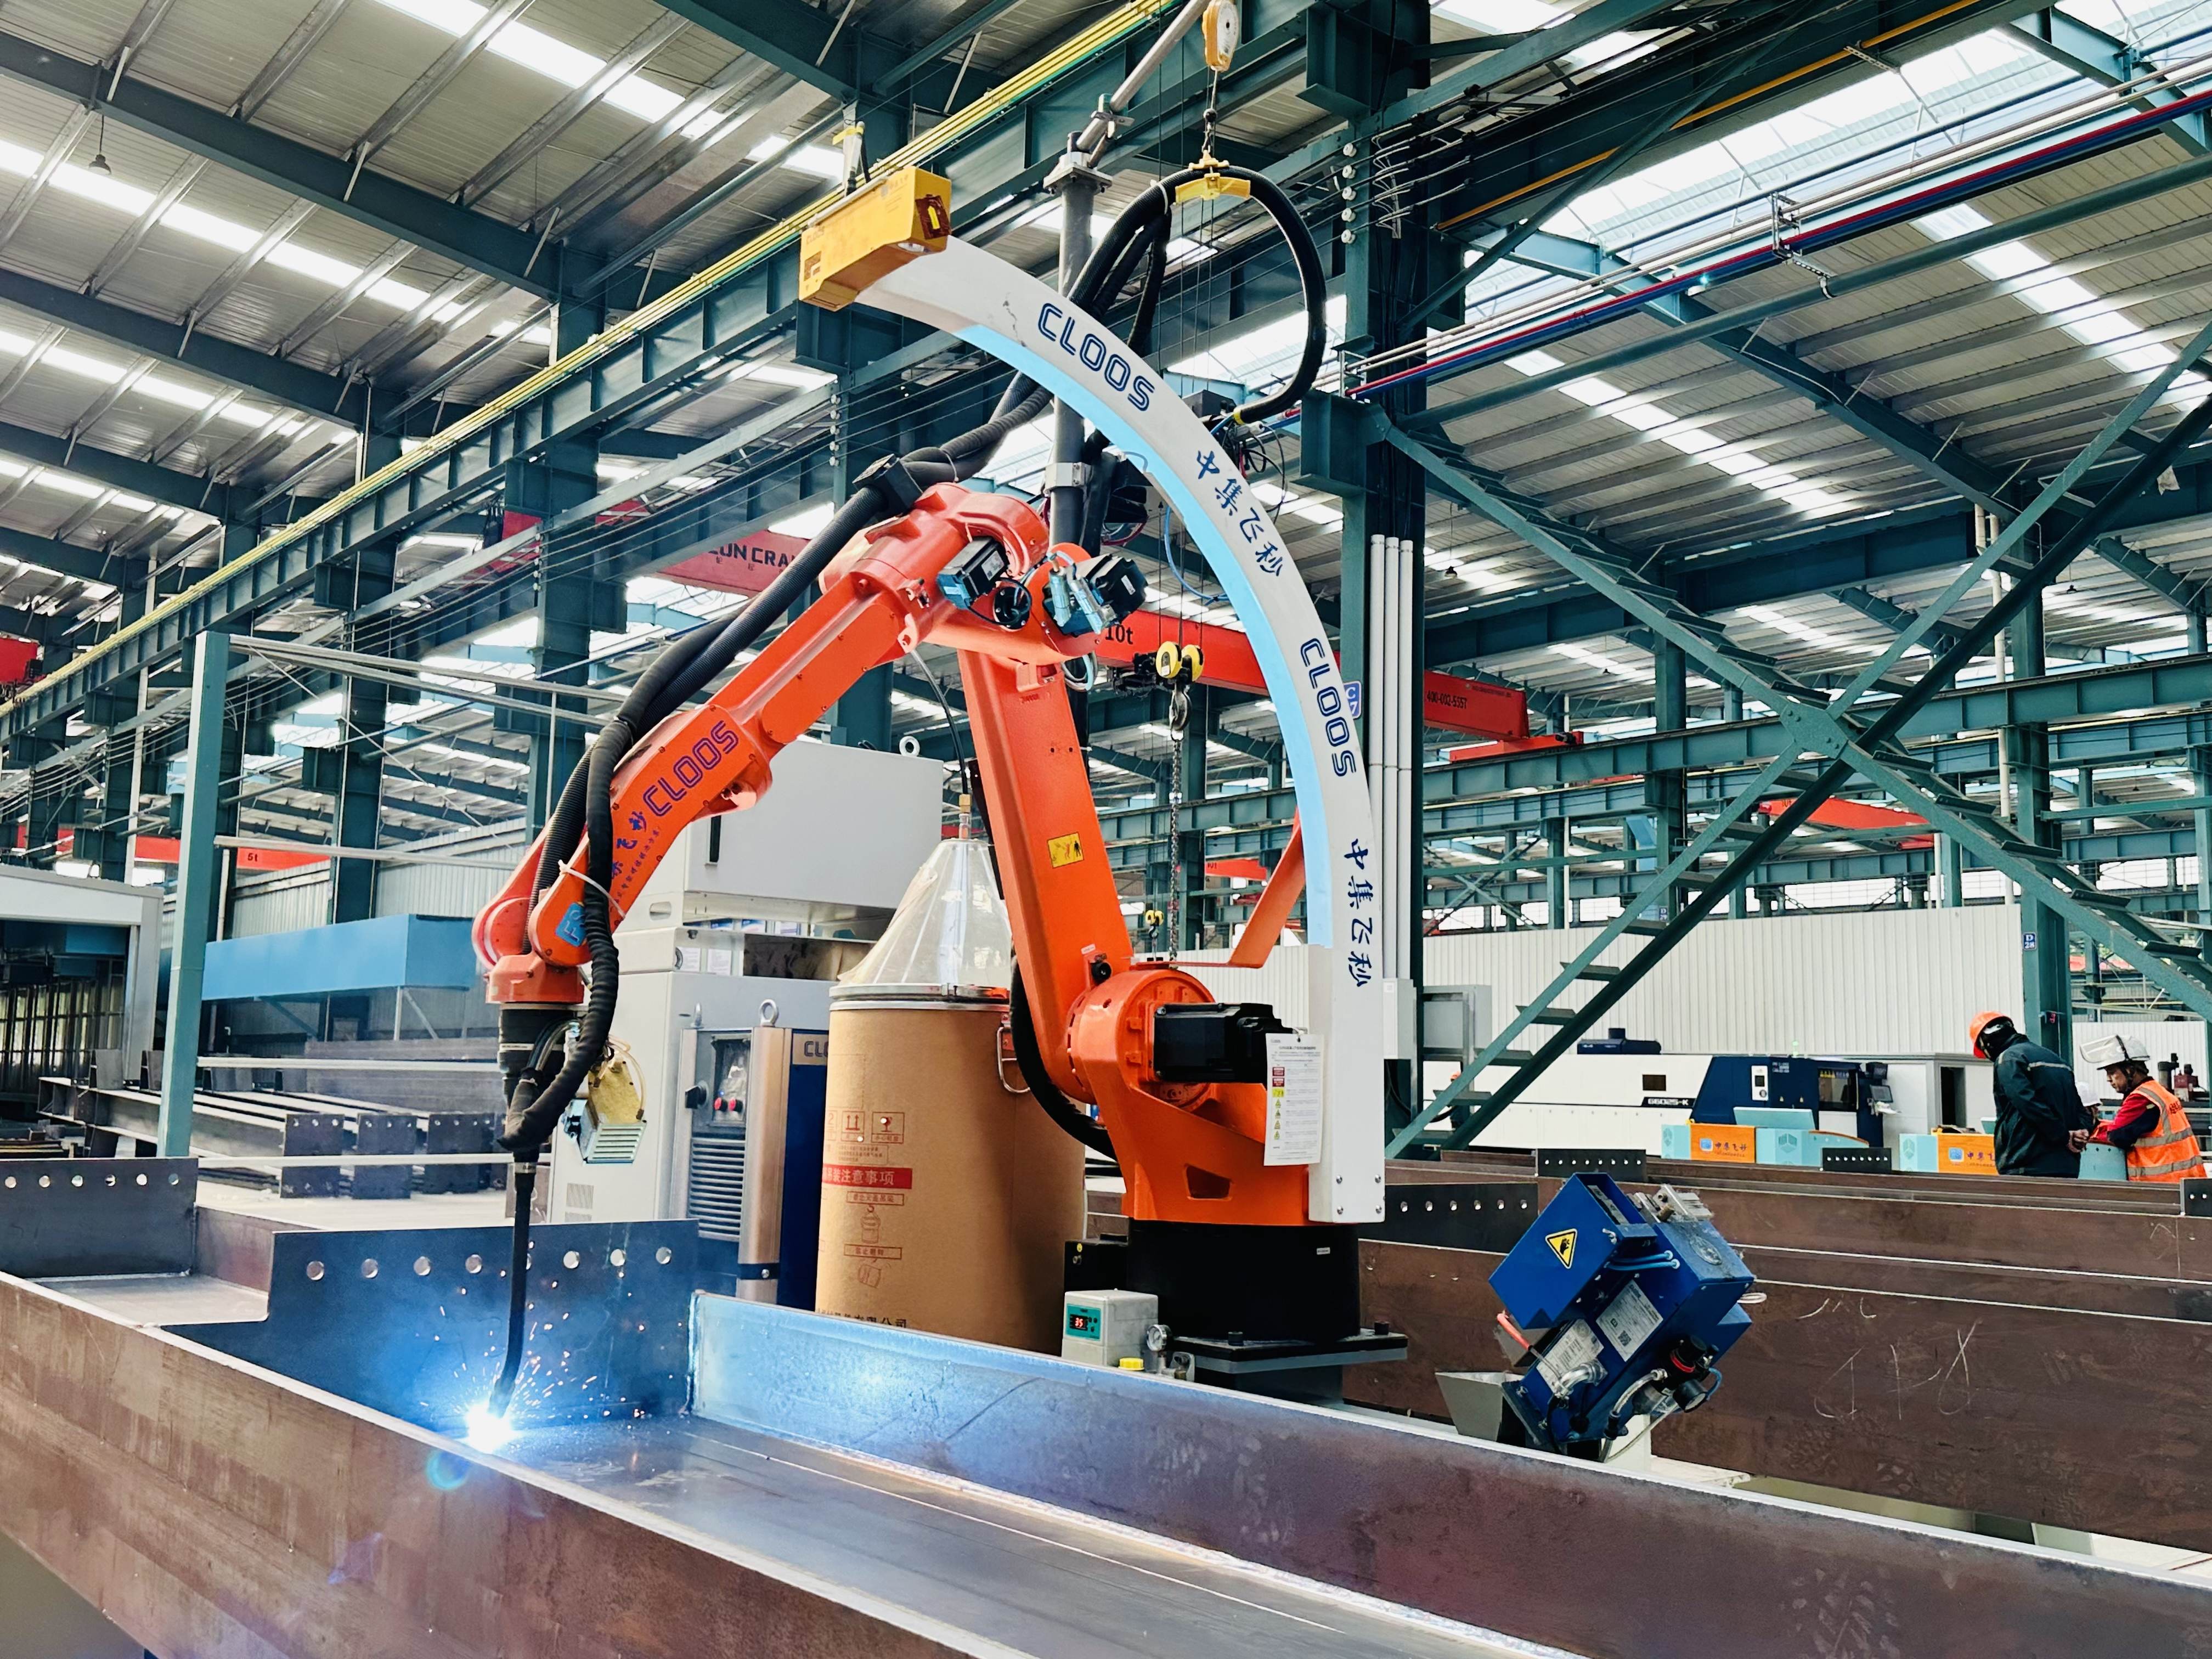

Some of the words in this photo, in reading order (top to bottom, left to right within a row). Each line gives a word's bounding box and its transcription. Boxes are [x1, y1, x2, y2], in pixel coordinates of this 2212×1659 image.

[1038, 303, 1155, 411] CLOOS
[1197, 450, 1283, 577] 中集飞秒
[1105, 625, 1133, 645] 10t
[1301, 638, 1356, 777] CLOOS
[1346, 687, 1356, 699] C
[1350, 701, 1358, 714] 7
[643, 720, 738, 816] CLOOS
[1344, 838, 1373, 987] 中集飞秒
